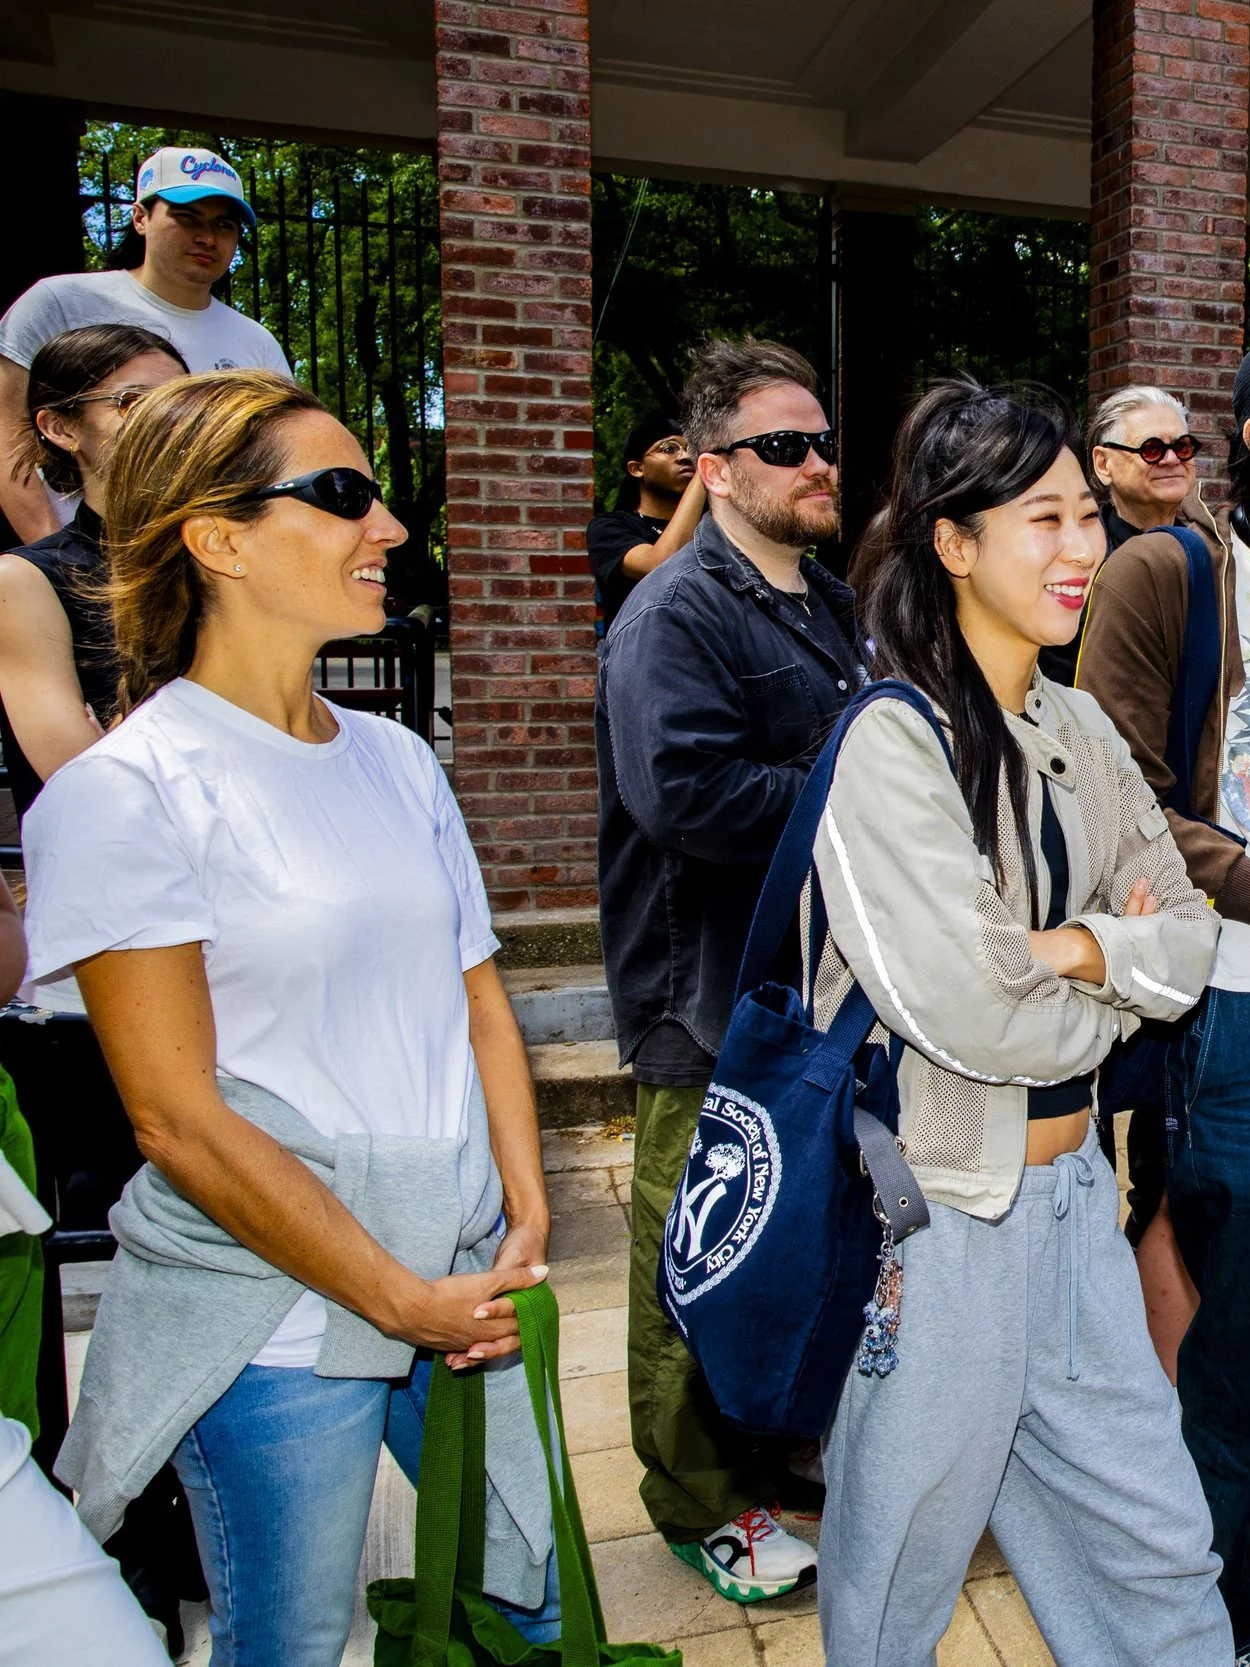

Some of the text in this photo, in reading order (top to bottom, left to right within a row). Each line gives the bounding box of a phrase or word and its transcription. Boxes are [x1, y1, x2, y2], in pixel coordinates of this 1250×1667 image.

[707, 1101, 770, 1274] Society of New York City
